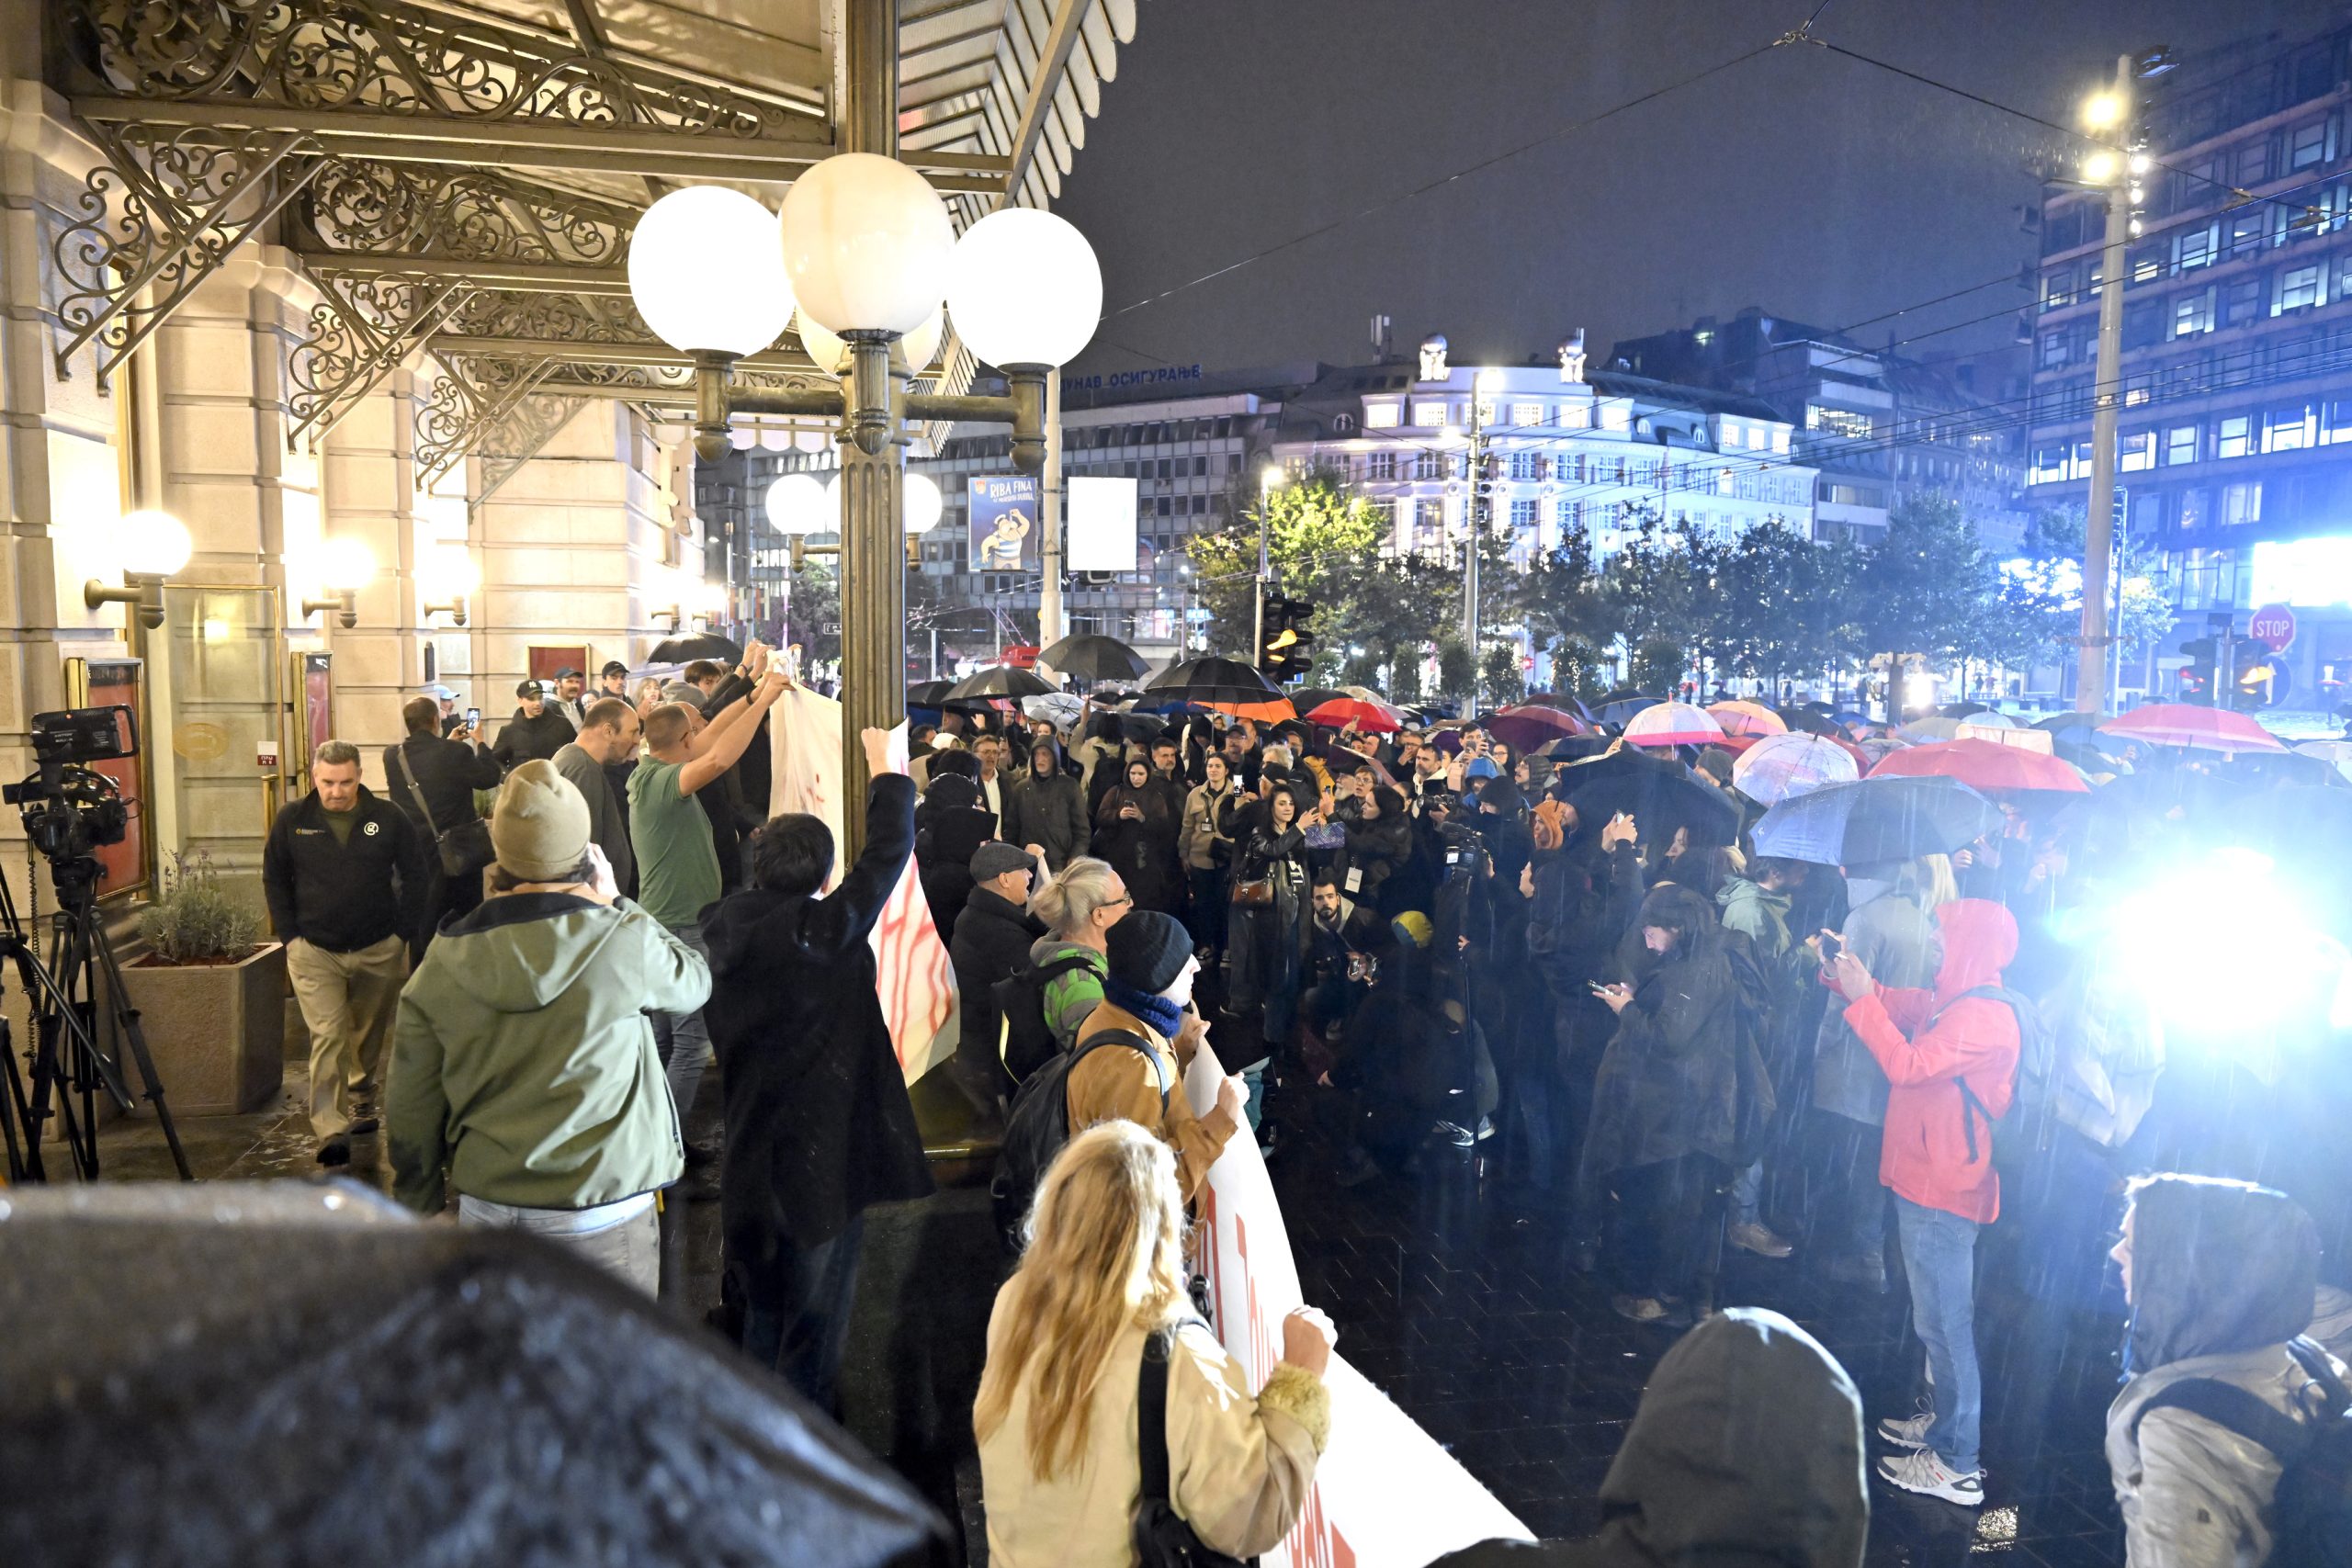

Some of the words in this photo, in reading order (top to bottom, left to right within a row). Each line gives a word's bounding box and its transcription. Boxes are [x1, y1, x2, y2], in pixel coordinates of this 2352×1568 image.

[1109, 365, 1202, 387] ОСИГУРАЊЕ
[990, 481, 1012, 498] RIBA
[1013, 479, 1033, 493] FINA
[2256, 620, 2290, 637] STOP
